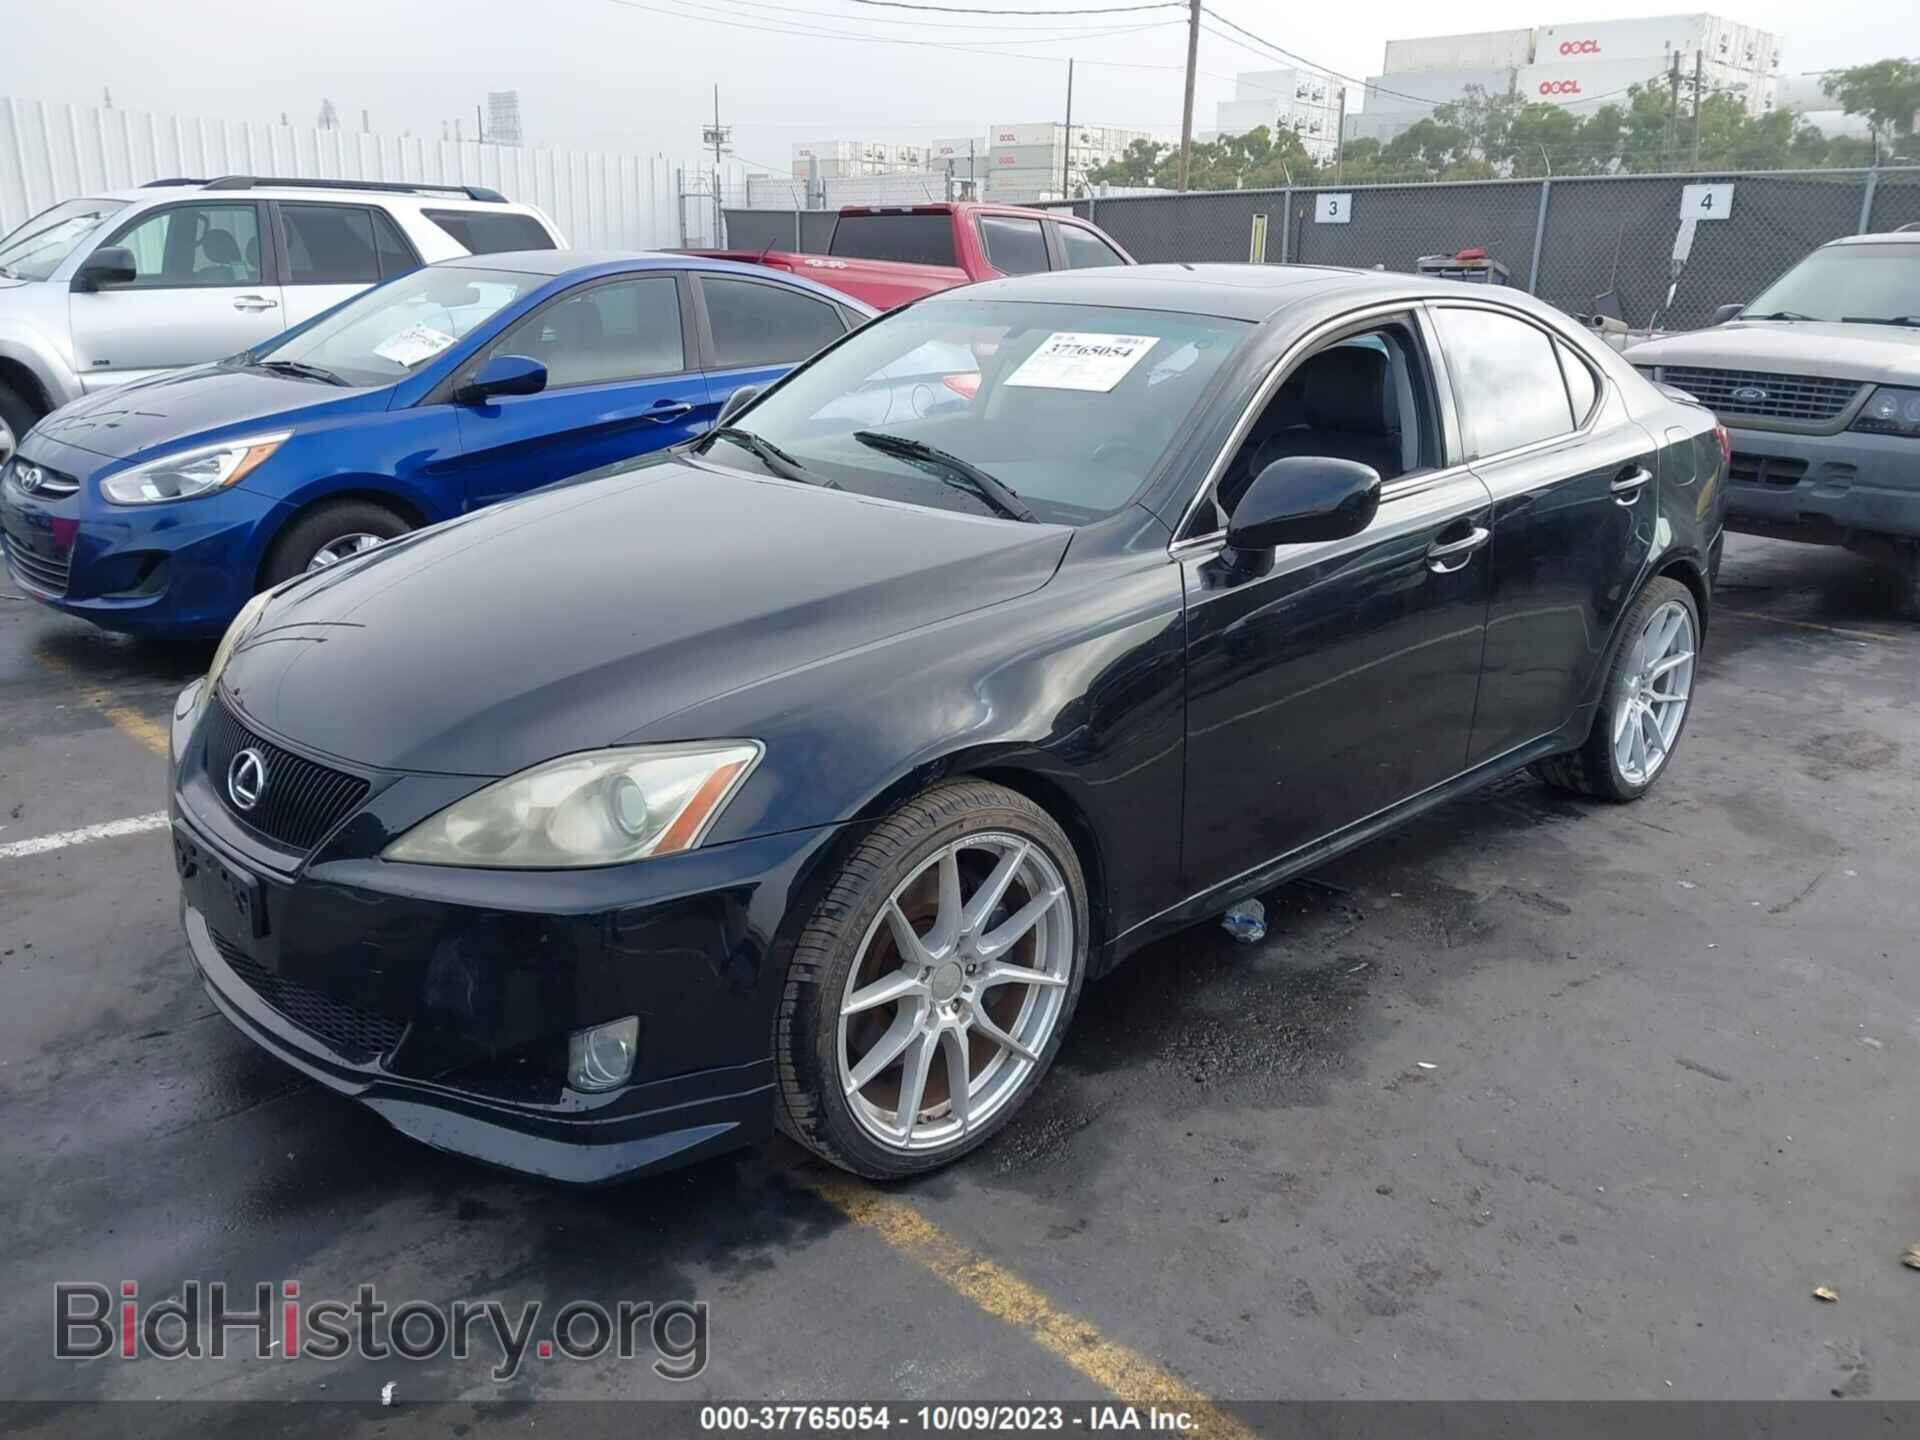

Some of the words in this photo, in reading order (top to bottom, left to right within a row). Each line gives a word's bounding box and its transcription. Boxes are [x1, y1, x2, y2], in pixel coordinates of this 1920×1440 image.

[1559, 40, 1601, 55] OOCL
[1539, 80, 1581, 95] OOCL
[1328, 200, 1338, 216] 3
[1700, 193, 1713, 211] 4
